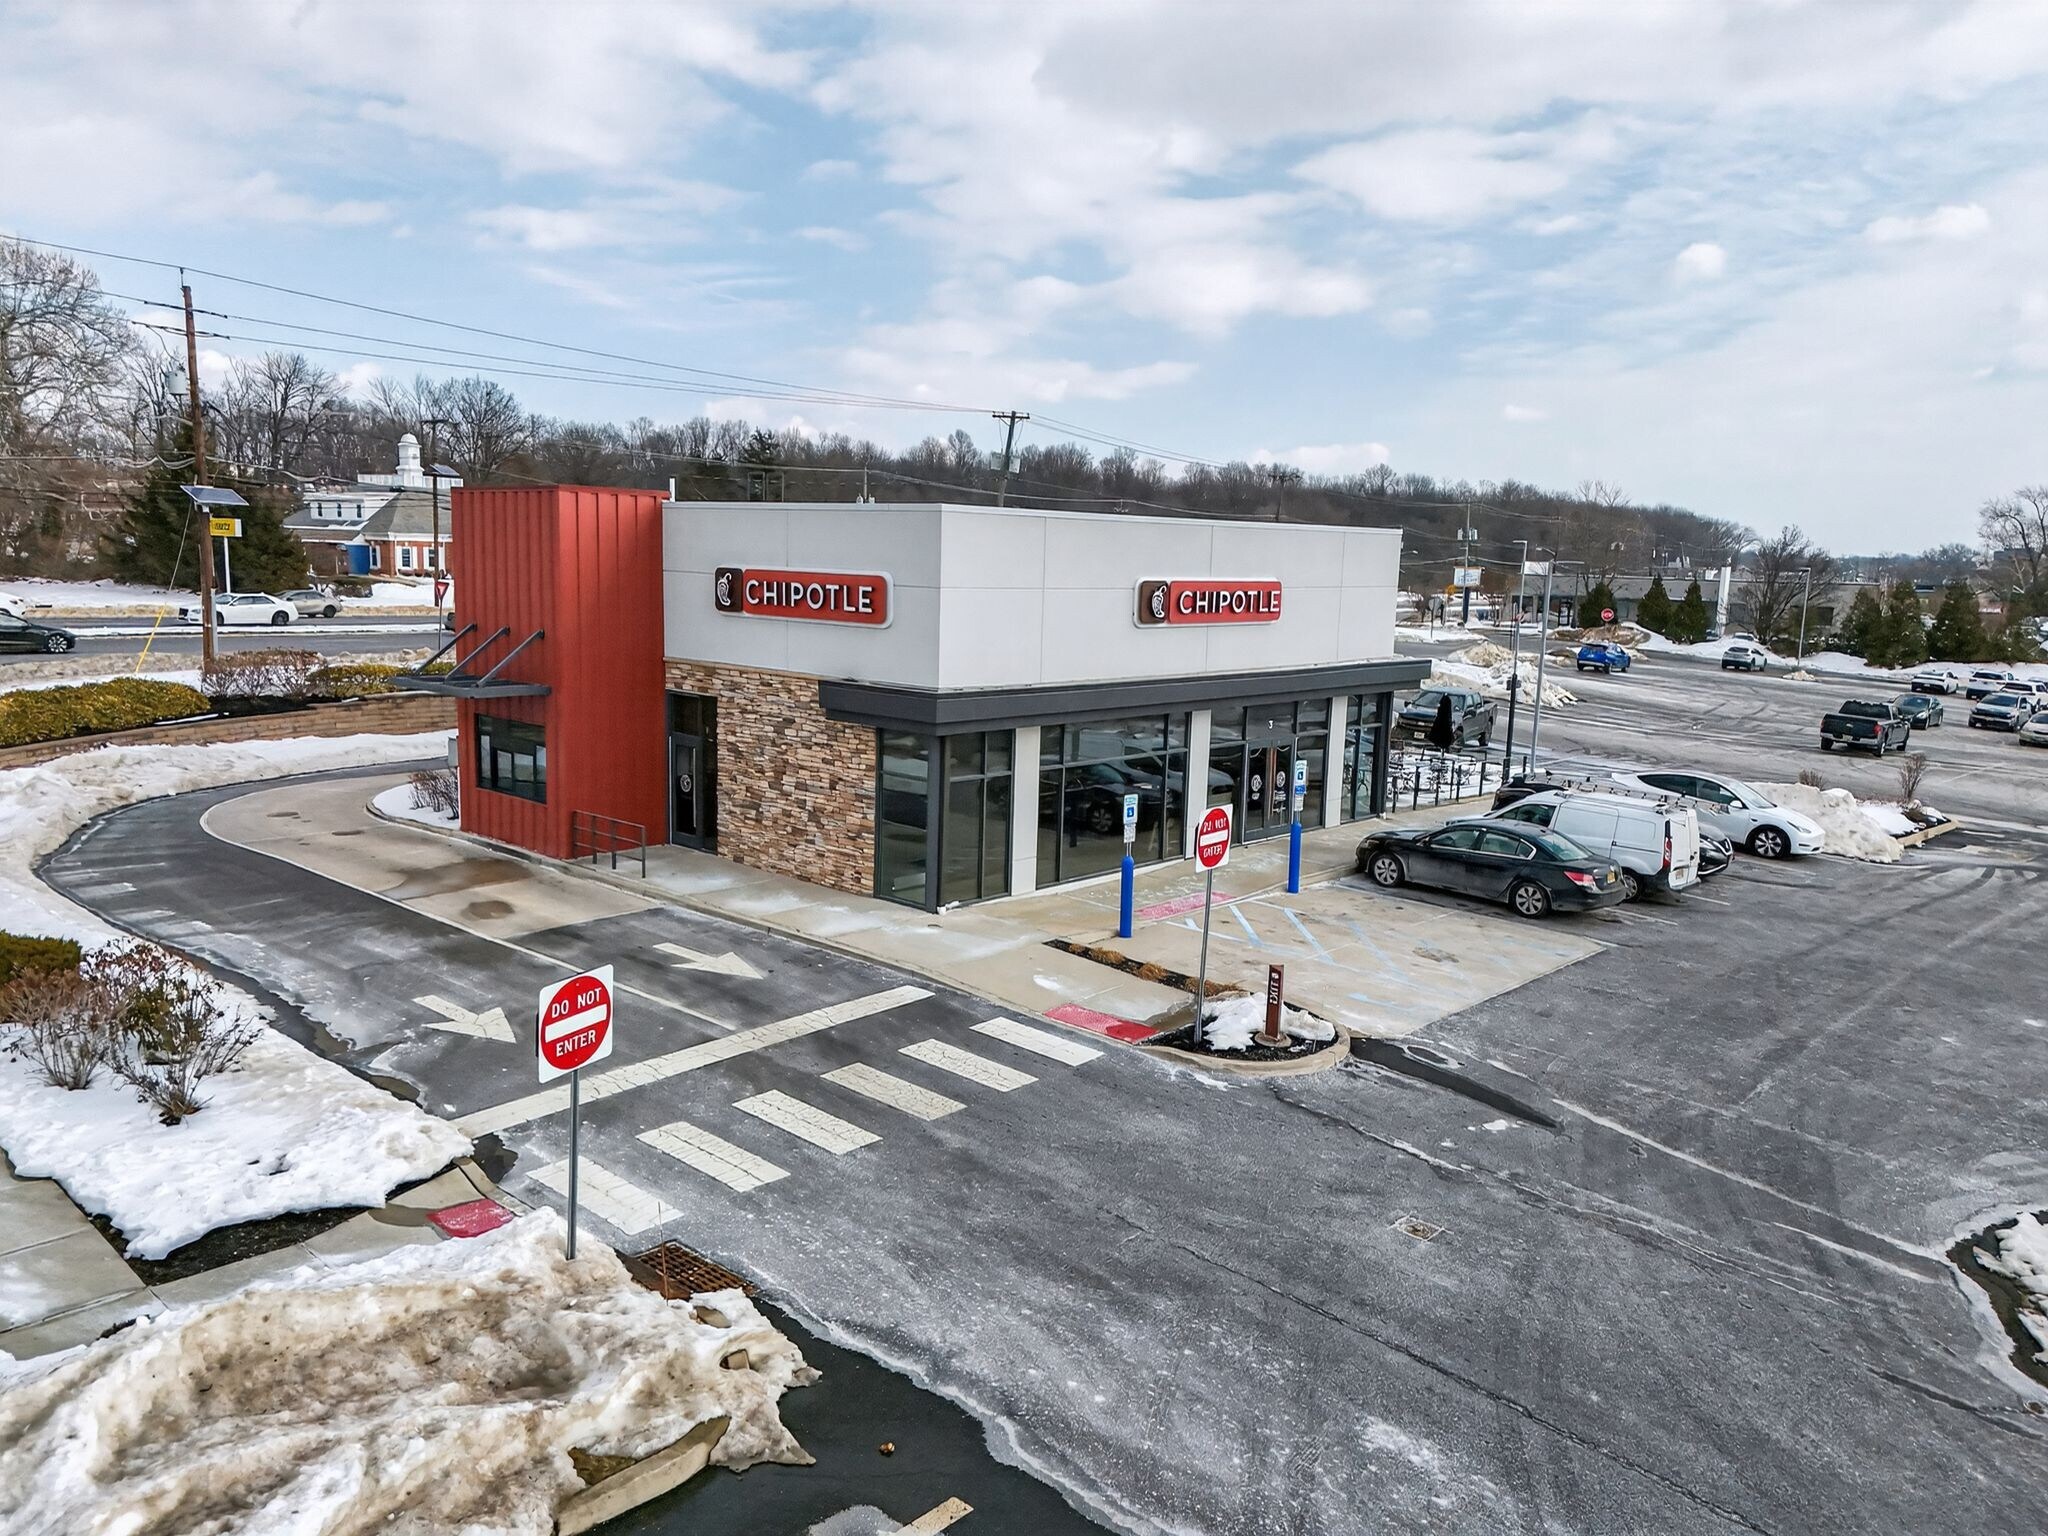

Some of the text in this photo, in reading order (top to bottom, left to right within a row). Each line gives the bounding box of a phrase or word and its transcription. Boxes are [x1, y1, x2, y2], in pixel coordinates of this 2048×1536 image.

[745, 579, 873, 614] CHIPOTLE
[1179, 590, 1281, 614] CHIPOTLE
[551, 987, 602, 1018] DO NOT
[556, 1029, 596, 1057] ENTER
